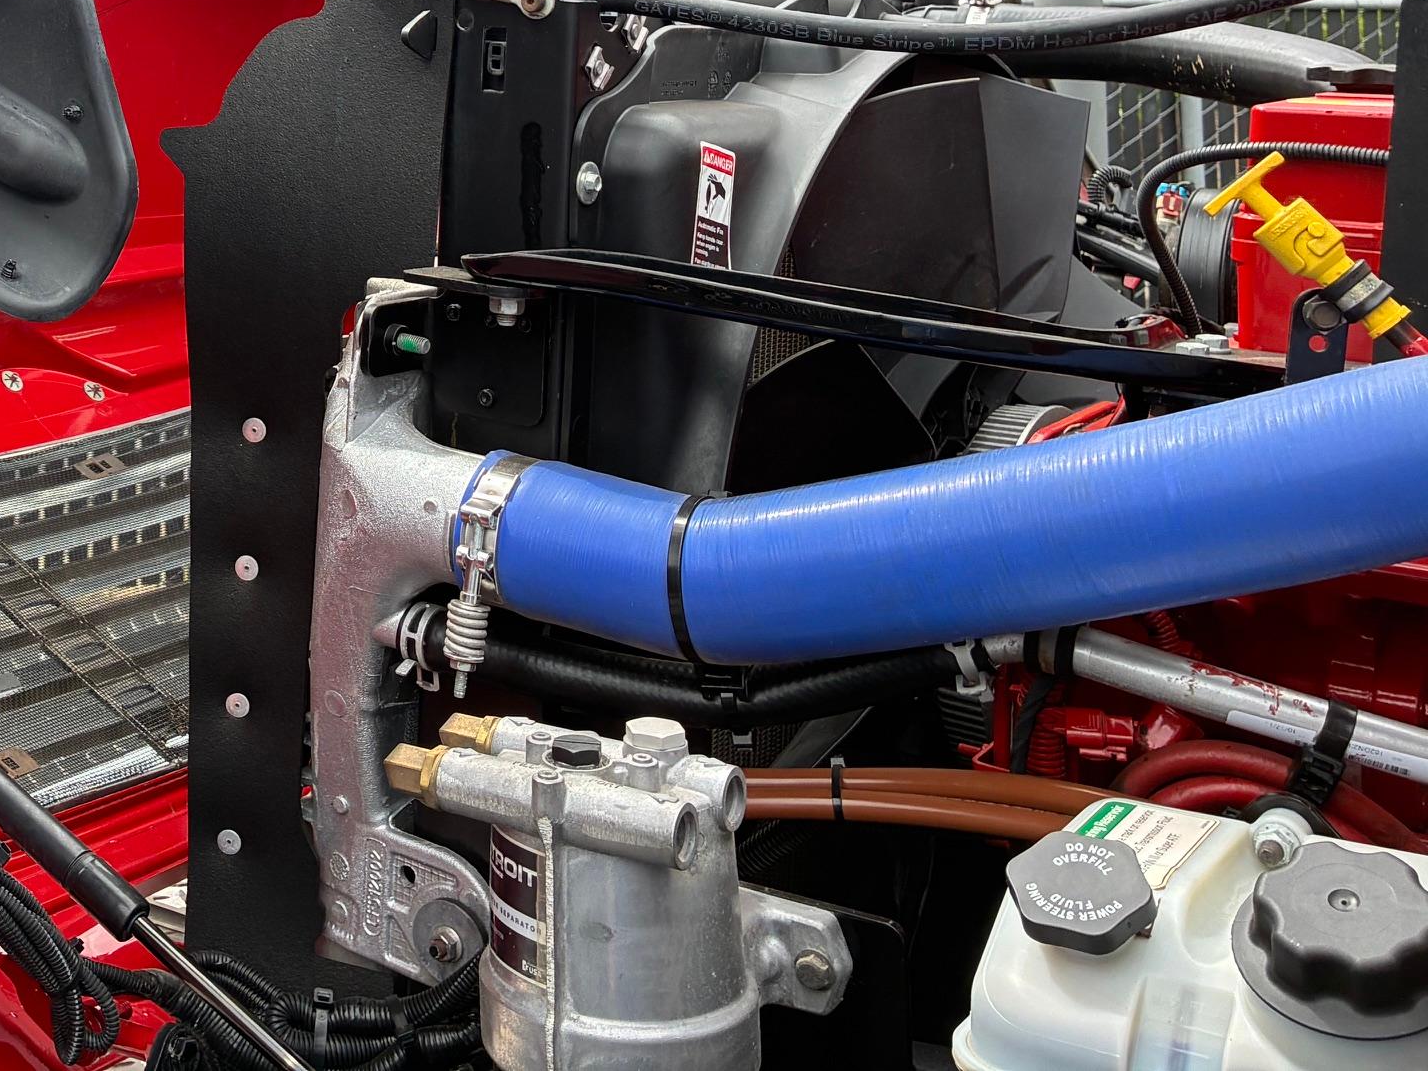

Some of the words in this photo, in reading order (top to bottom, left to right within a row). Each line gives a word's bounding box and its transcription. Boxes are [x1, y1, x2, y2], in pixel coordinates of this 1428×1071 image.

[727, 13, 810, 40] 4230SB
[817, 27, 864, 45] Blue
[963, 35, 1036, 52] EPDM
[1043, 29, 1114, 48] Heater
[710, 154, 733, 172] DANGER
[1065, 842, 1084, 853] DO
[1088, 844, 1116, 861] NOT
[1052, 852, 1114, 876] OVERFILL
[1025, 882, 1075, 921] STEERING
[1050, 893, 1094, 911] FLUID
[1078, 900, 1123, 921] POWER
